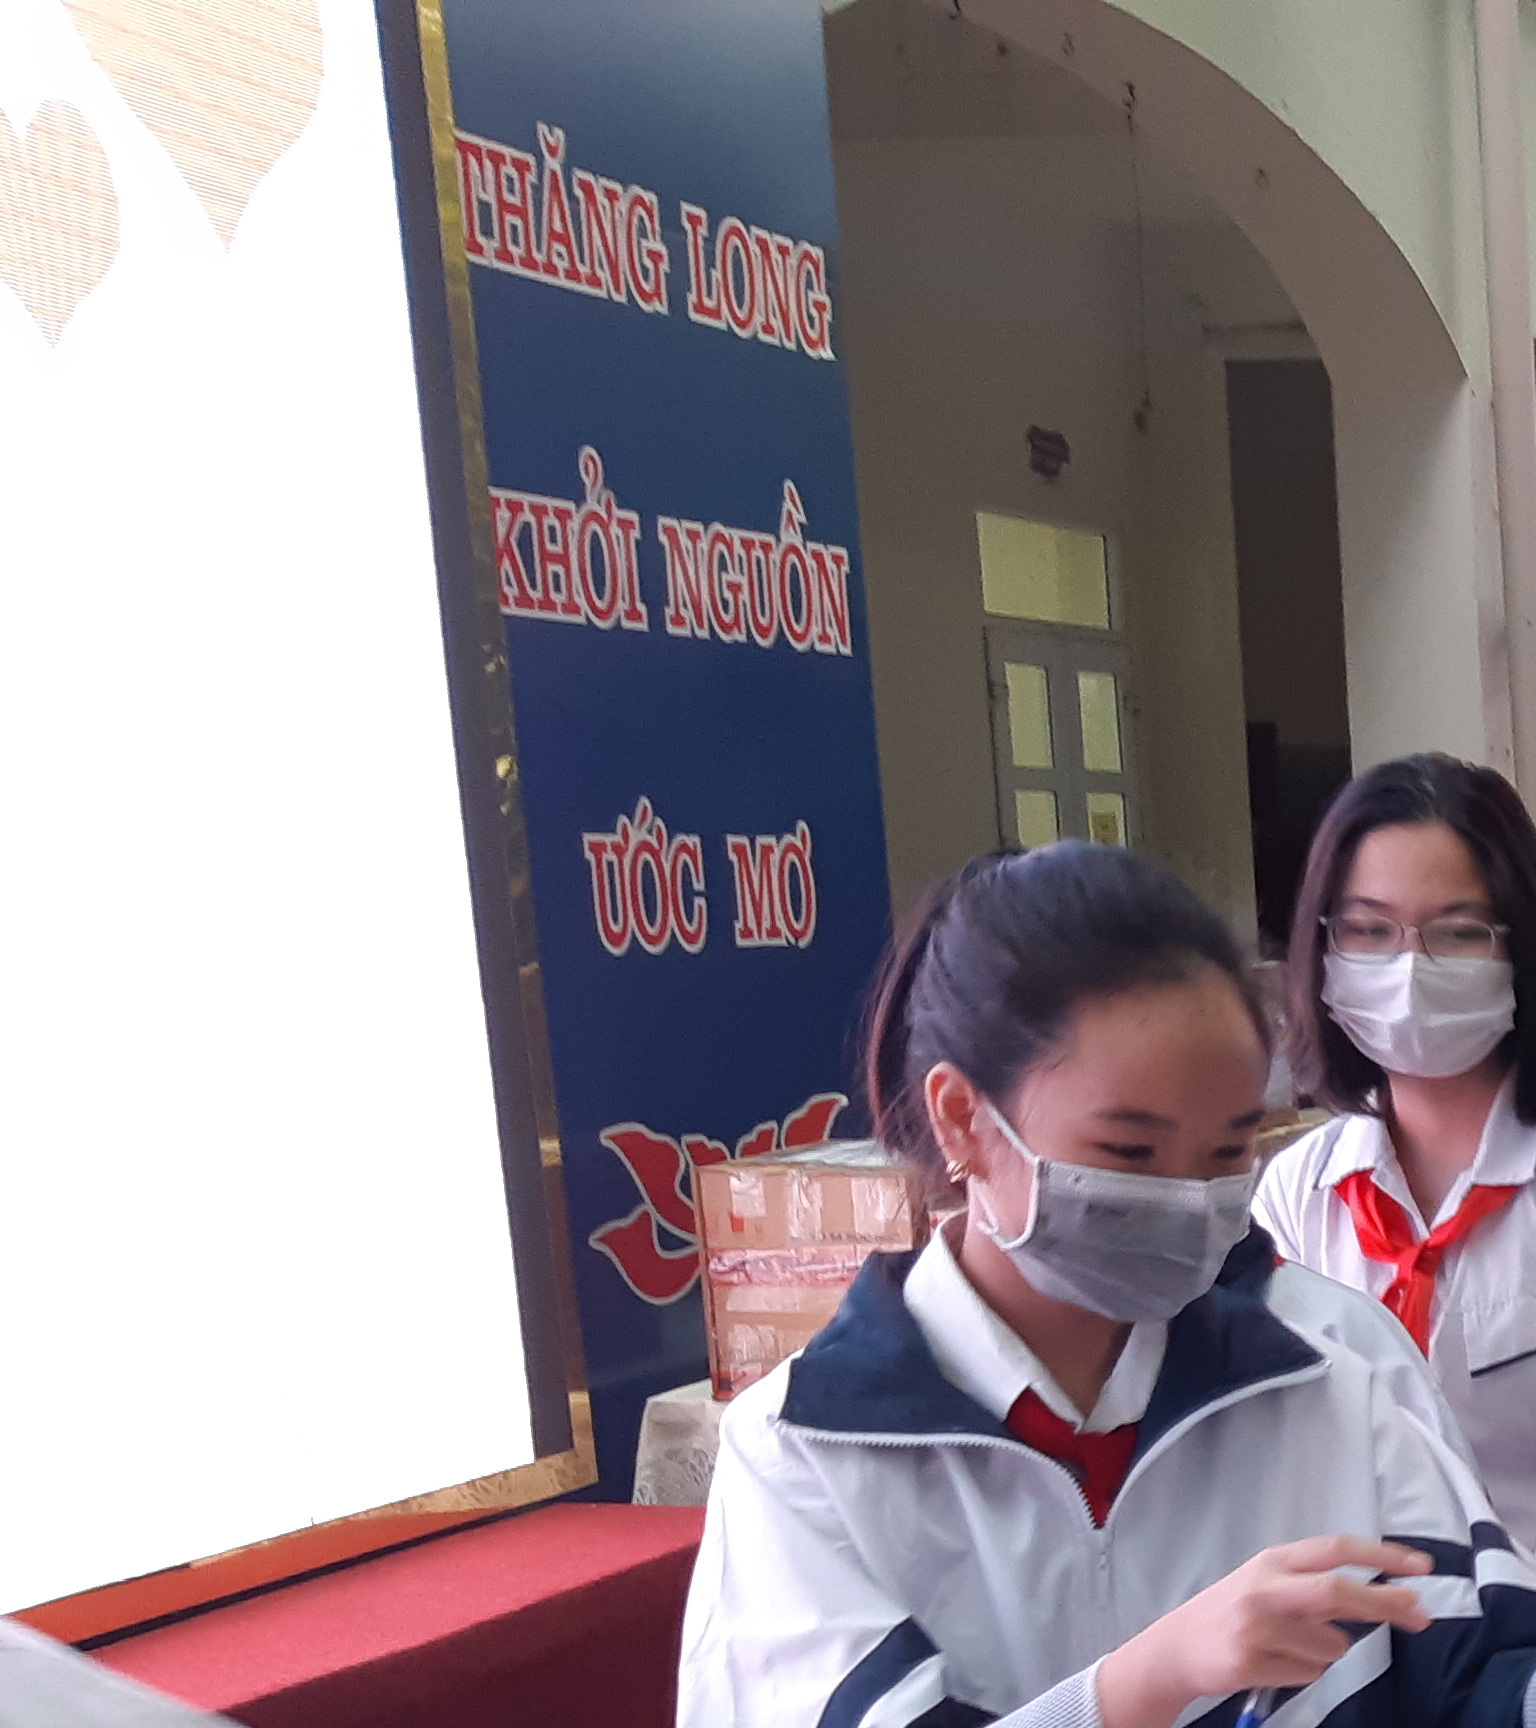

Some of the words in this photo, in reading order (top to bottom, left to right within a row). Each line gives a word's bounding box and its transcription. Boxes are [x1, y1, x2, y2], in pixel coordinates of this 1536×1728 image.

[453, 121, 670, 315] THĂNG
[680, 201, 837, 361] LONG
[488, 444, 648, 632] KHỞI
[657, 478, 853, 656] NGUỒN
[582, 795, 706, 956] ƯỚC
[725, 820, 816, 949] MƠ
